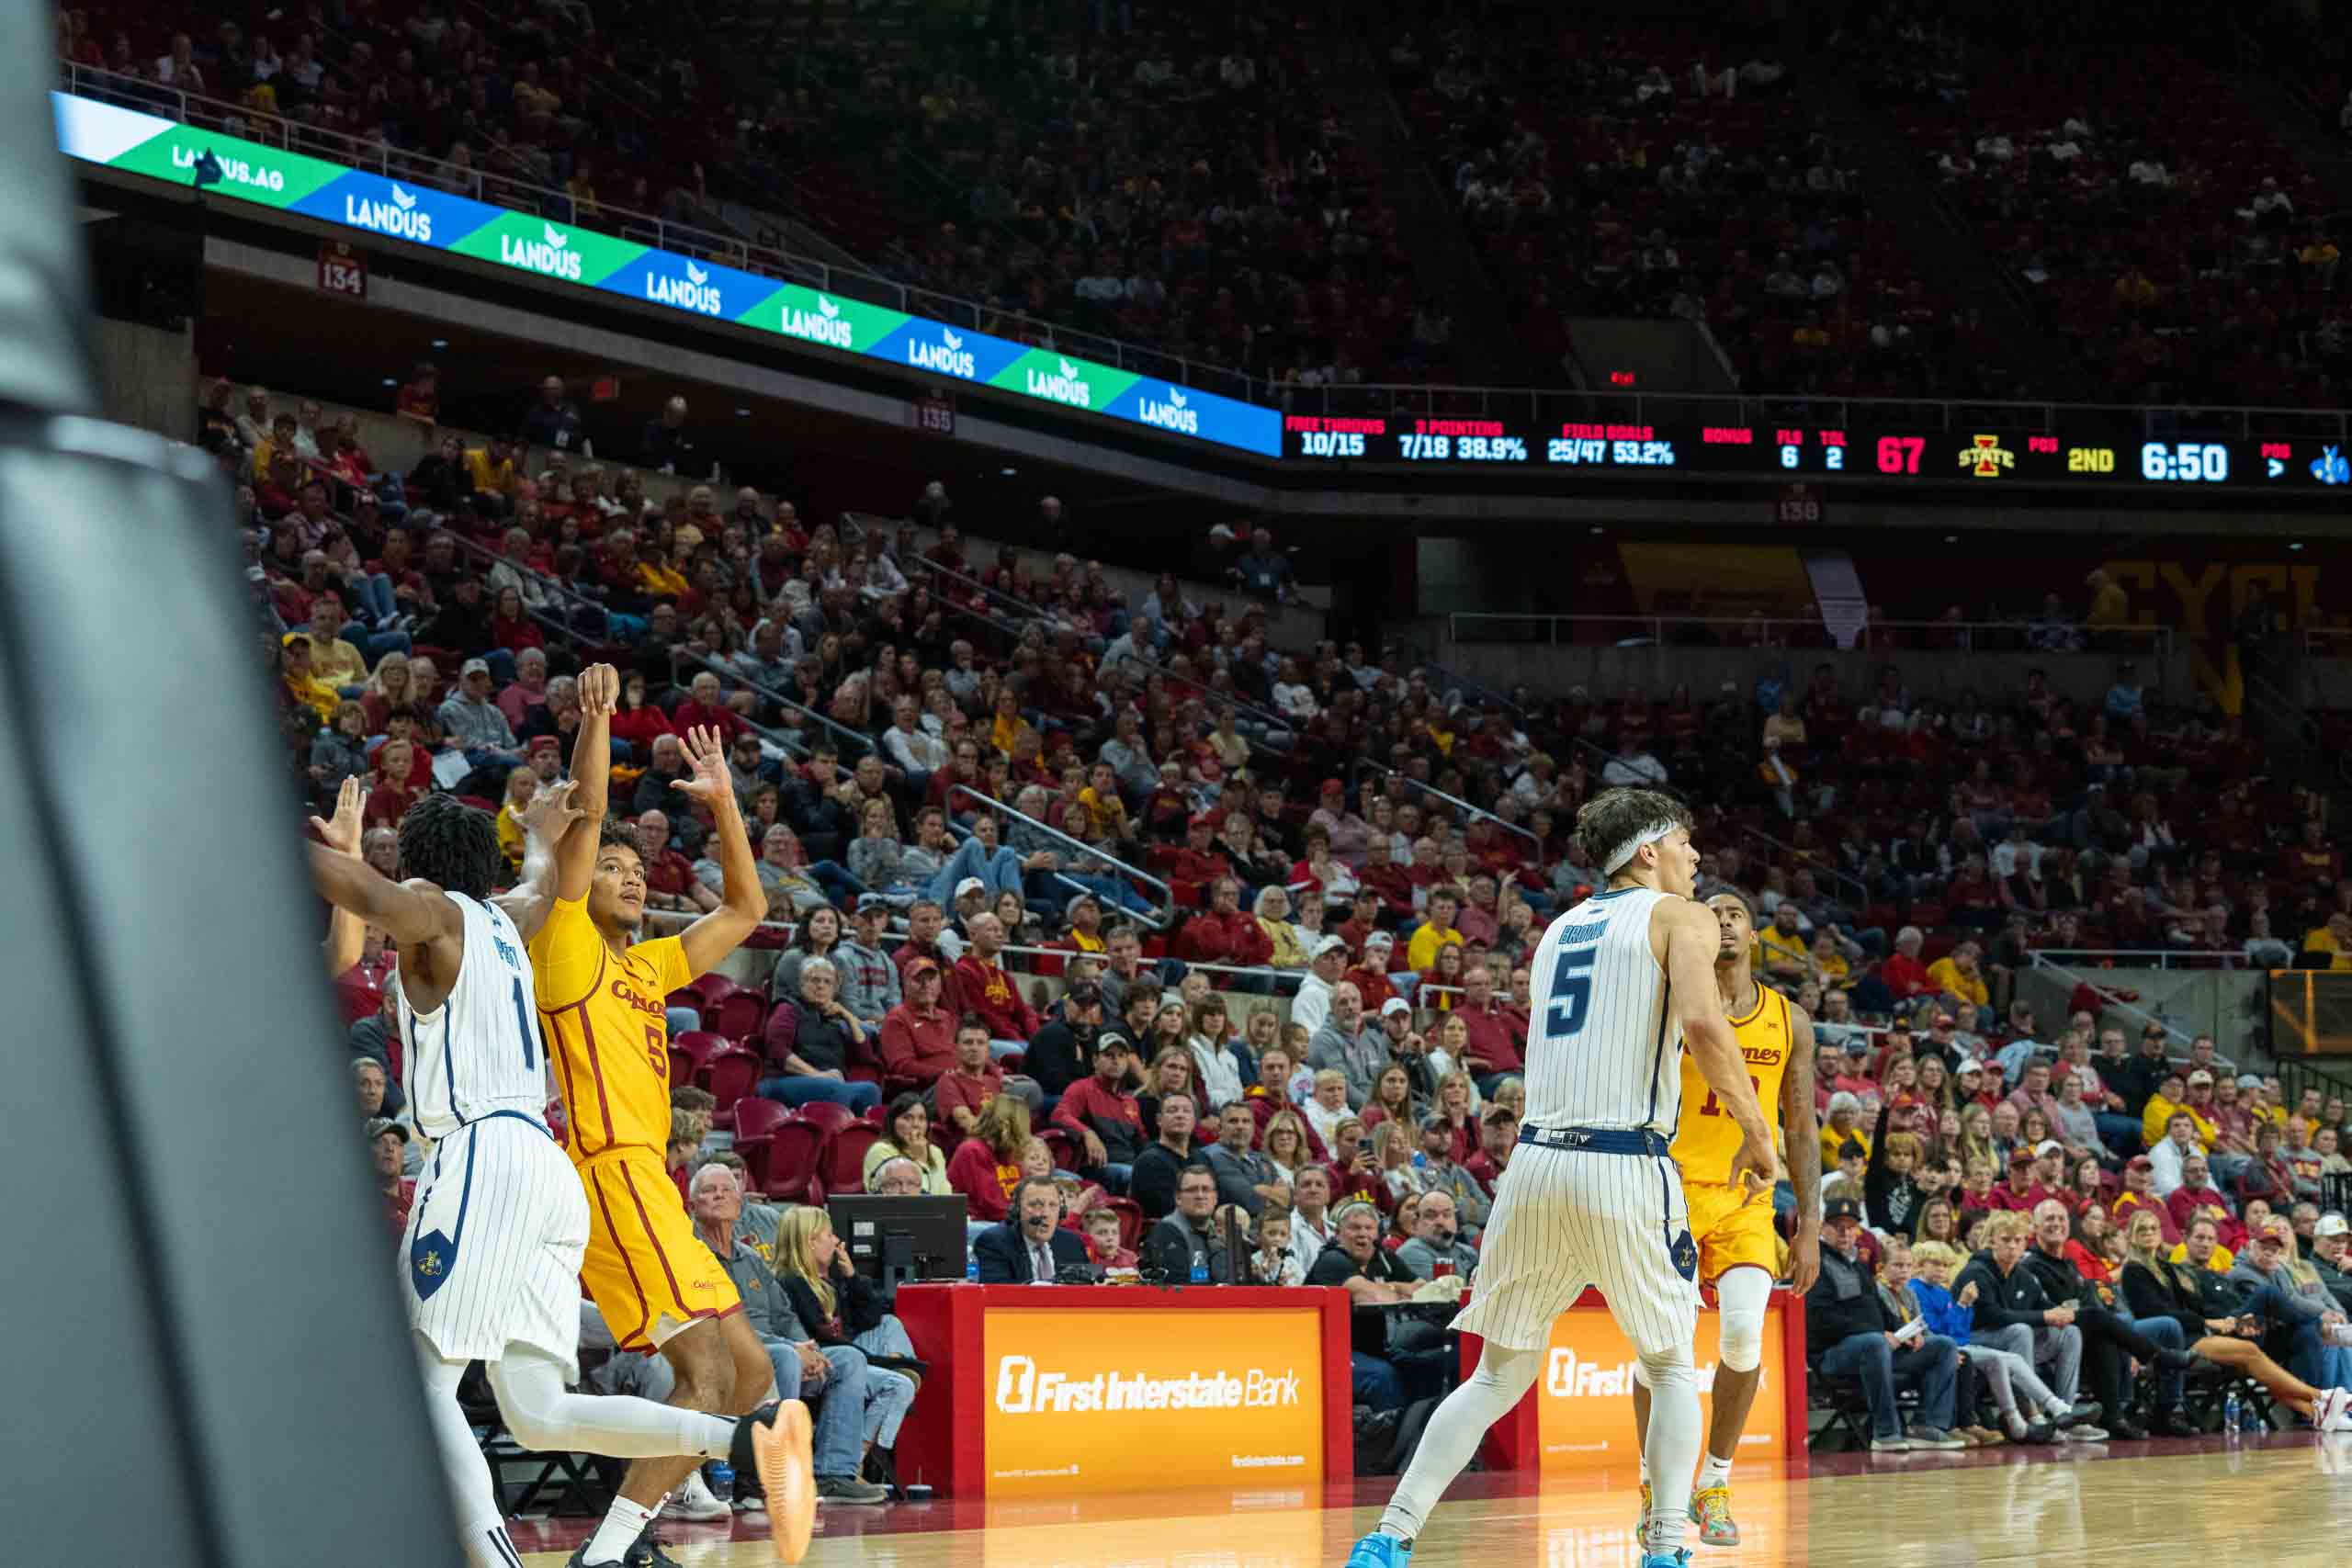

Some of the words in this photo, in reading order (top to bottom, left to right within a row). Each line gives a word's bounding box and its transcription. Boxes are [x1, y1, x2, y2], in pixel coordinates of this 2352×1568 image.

[172, 144, 284, 192] LAUS.AG
[345, 195, 433, 243] LANDUS
[501, 234, 582, 281] LANDUS
[322, 263, 362, 294] 134
[646, 274, 722, 315] LANDUS
[781, 307, 853, 347] LANDUS
[908, 341, 975, 378] LANDUS
[1027, 370, 1091, 406] LANDUS
[1138, 398, 1198, 435] LANDUS
[1301, 432, 1365, 457] 10/15
[1398, 434, 1449, 459] 7/18
[1456, 436, 1527, 460] 38.9%
[1547, 438, 1606, 463] 25/47
[1612, 441, 1675, 465] 53.2%
[1781, 446, 1798, 468] 6
[1826, 446, 1843, 469] 2
[1877, 436, 1925, 474] 67
[1958, 446, 2015, 468] STATE
[2067, 448, 2115, 472] 2ND
[2142, 442, 2228, 481] 6:50
[1545, 947, 1598, 1040] 5
[512, 976, 535, 1073] 1
[644, 1023, 667, 1079] 5
[1035, 1372, 1104, 1413] First
[1104, 1371, 1243, 1412] Interstate
[1244, 1367, 1300, 1407] Bank
[1574, 1361, 1624, 1397] First
